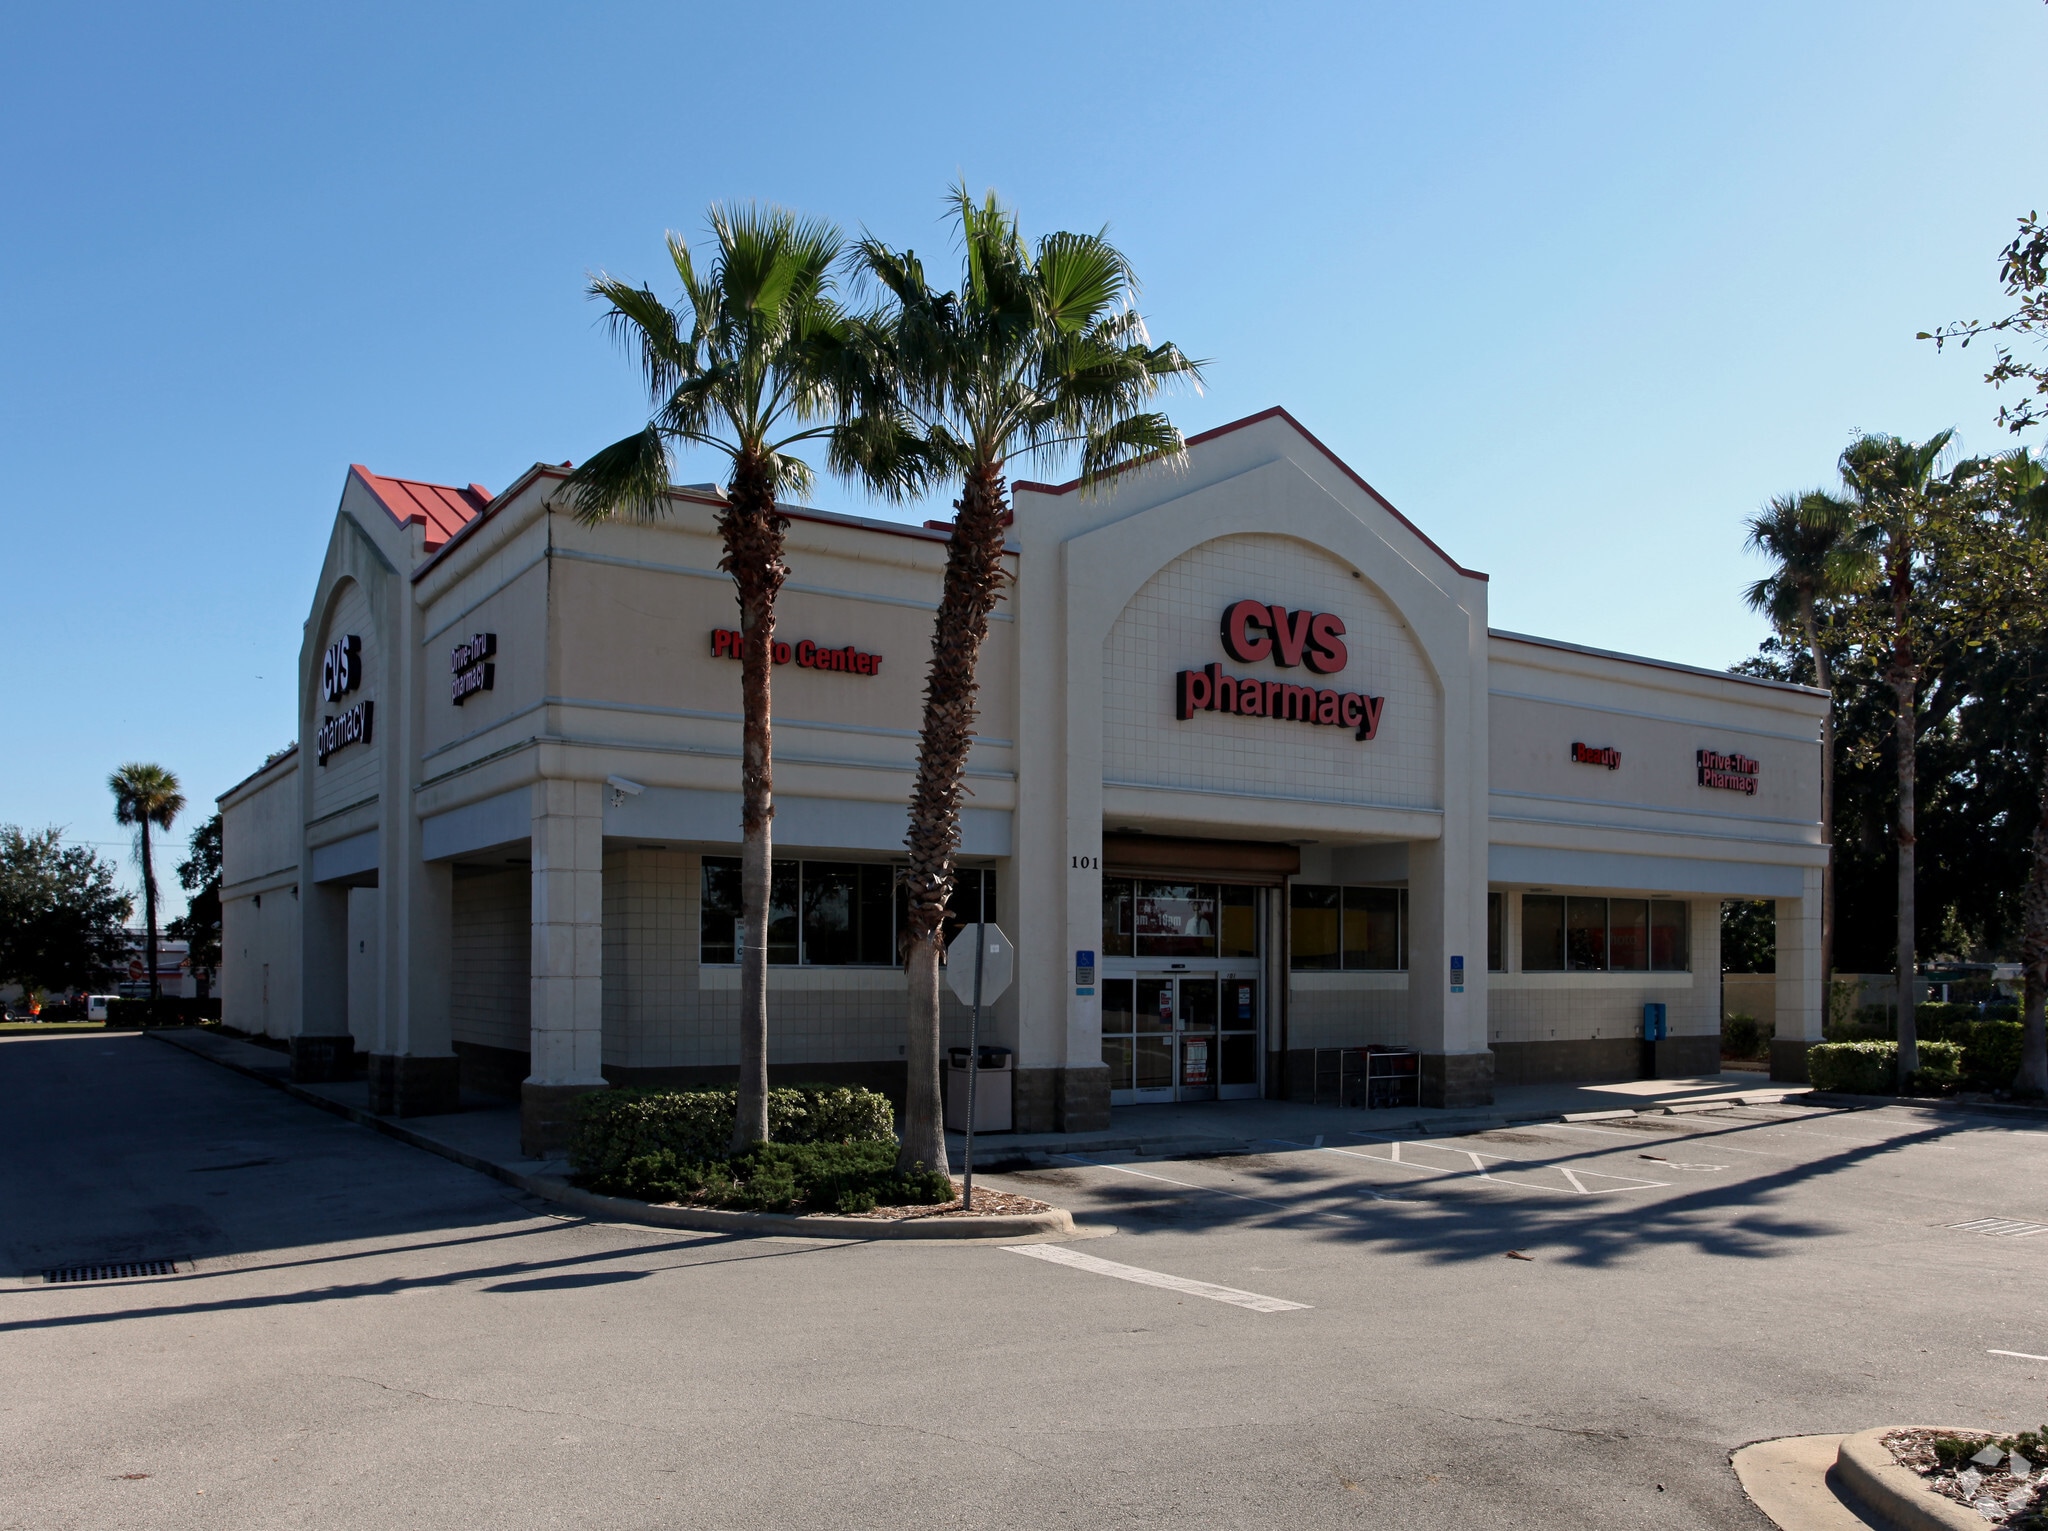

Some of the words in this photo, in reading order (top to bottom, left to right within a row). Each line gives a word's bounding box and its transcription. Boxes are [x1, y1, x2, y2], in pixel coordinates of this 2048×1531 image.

[450, 634, 488, 673] Drive-Thru
[711, 629, 791, 665] Pho
[799, 639, 882, 675] Center
[1224, 599, 1348, 674] CVS
[322, 634, 352, 702] CVS
[451, 662, 486, 705] pharmacy
[1183, 662, 1385, 741] pharmacy
[317, 702, 367, 766] pharmacy
[1575, 742, 1621, 770] Beauty
[1702, 750, 1759, 775] Drive-Thru
[1703, 768, 1759, 795] Pharmacy
[1072, 856, 1098, 869] 101
